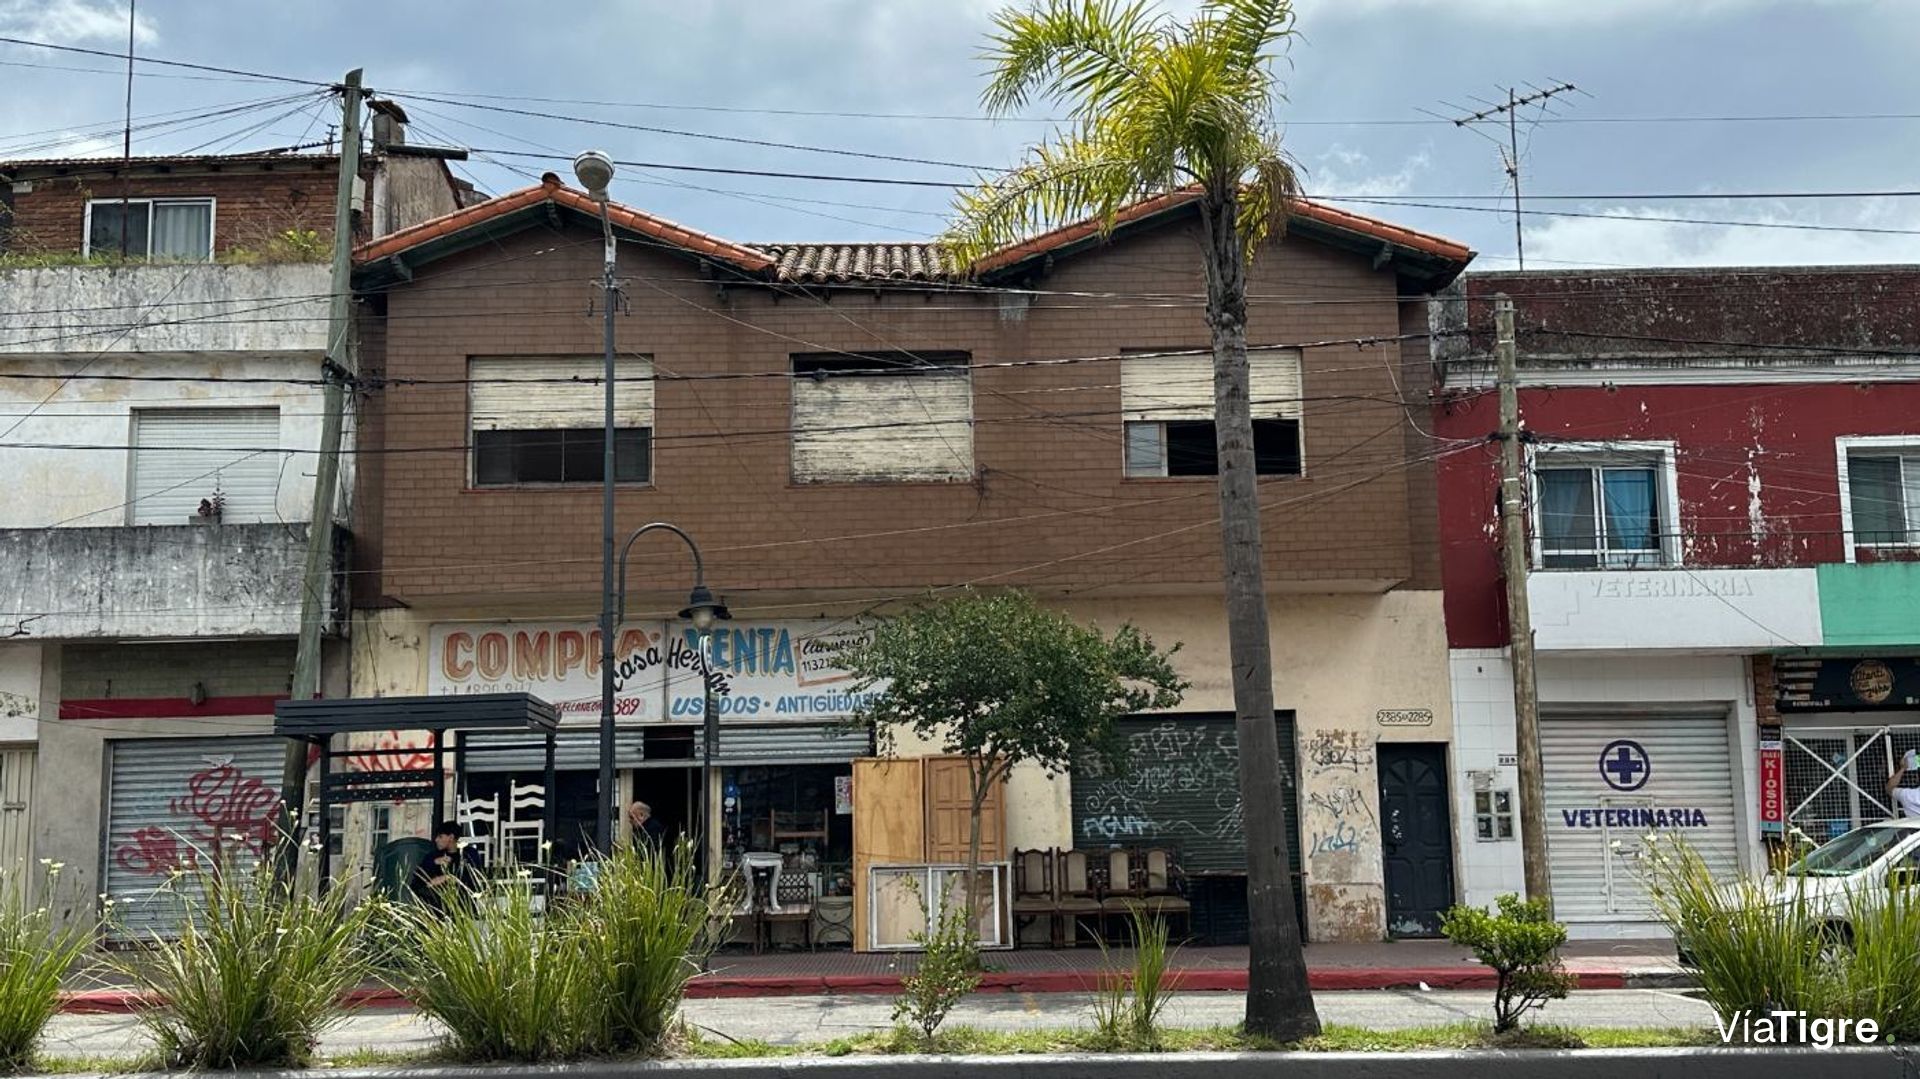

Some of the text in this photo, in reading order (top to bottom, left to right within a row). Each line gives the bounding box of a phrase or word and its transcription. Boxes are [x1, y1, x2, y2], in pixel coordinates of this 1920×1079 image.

[1591, 576, 1754, 598] VETERINARIA
[671, 695, 760, 715] USDOS
[1765, 760, 1778, 819] KIOSCO
[1562, 808, 1708, 828] VETERINARIA
